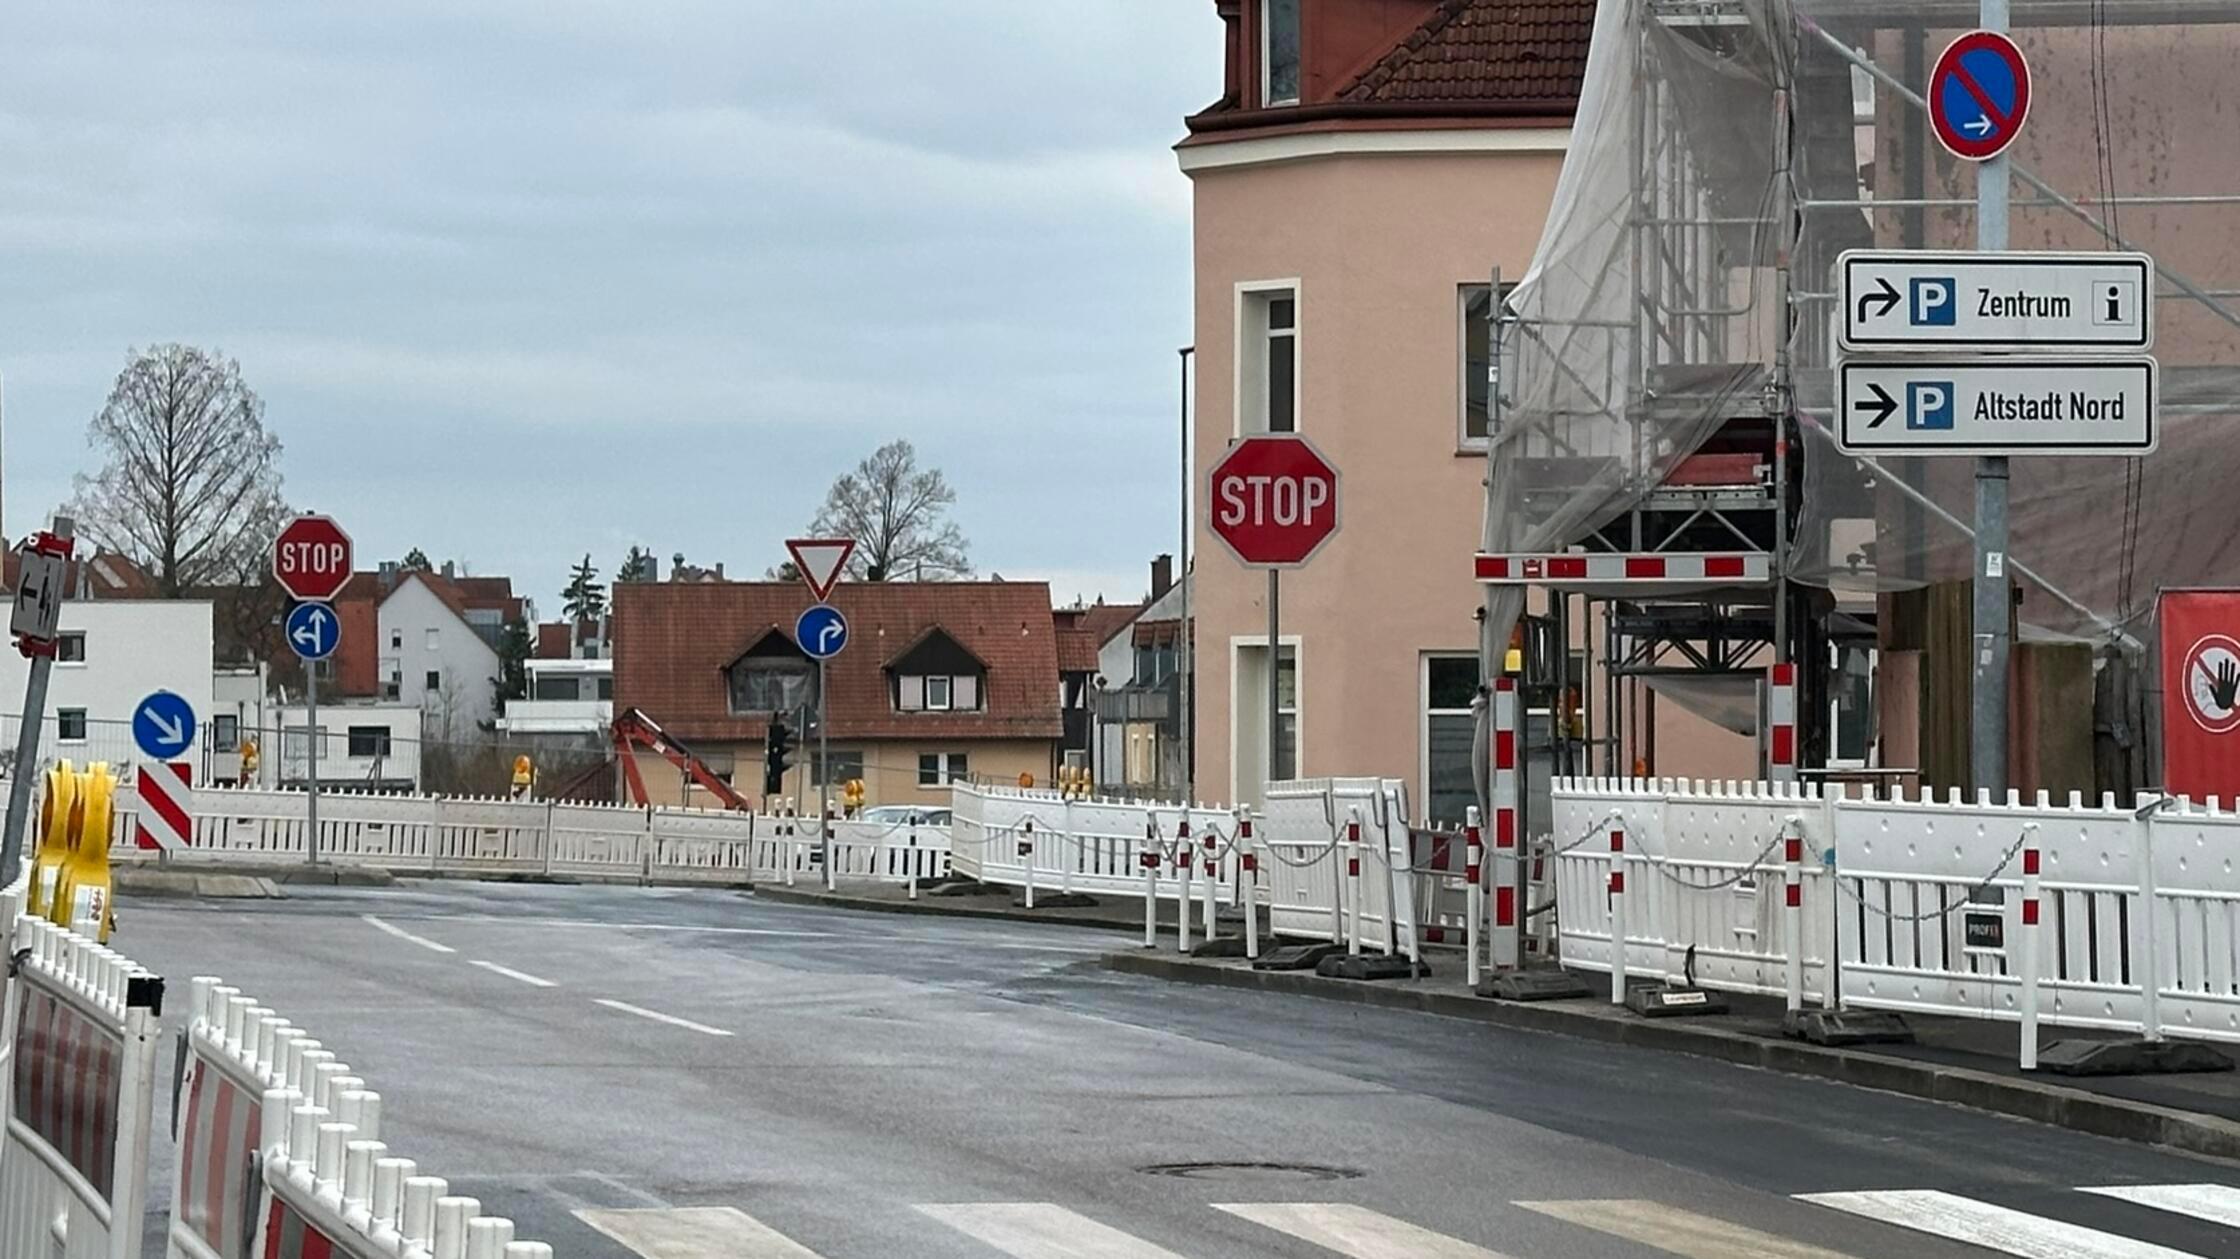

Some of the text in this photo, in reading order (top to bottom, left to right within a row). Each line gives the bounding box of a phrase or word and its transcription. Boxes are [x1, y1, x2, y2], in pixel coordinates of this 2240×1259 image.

[1918, 282, 1947, 321] P
[1977, 289, 2070, 318] Zentrum
[1915, 387, 2124, 425] P Altstadt Nord
[1221, 476, 1327, 526] STOP
[282, 542, 344, 574] STOP
